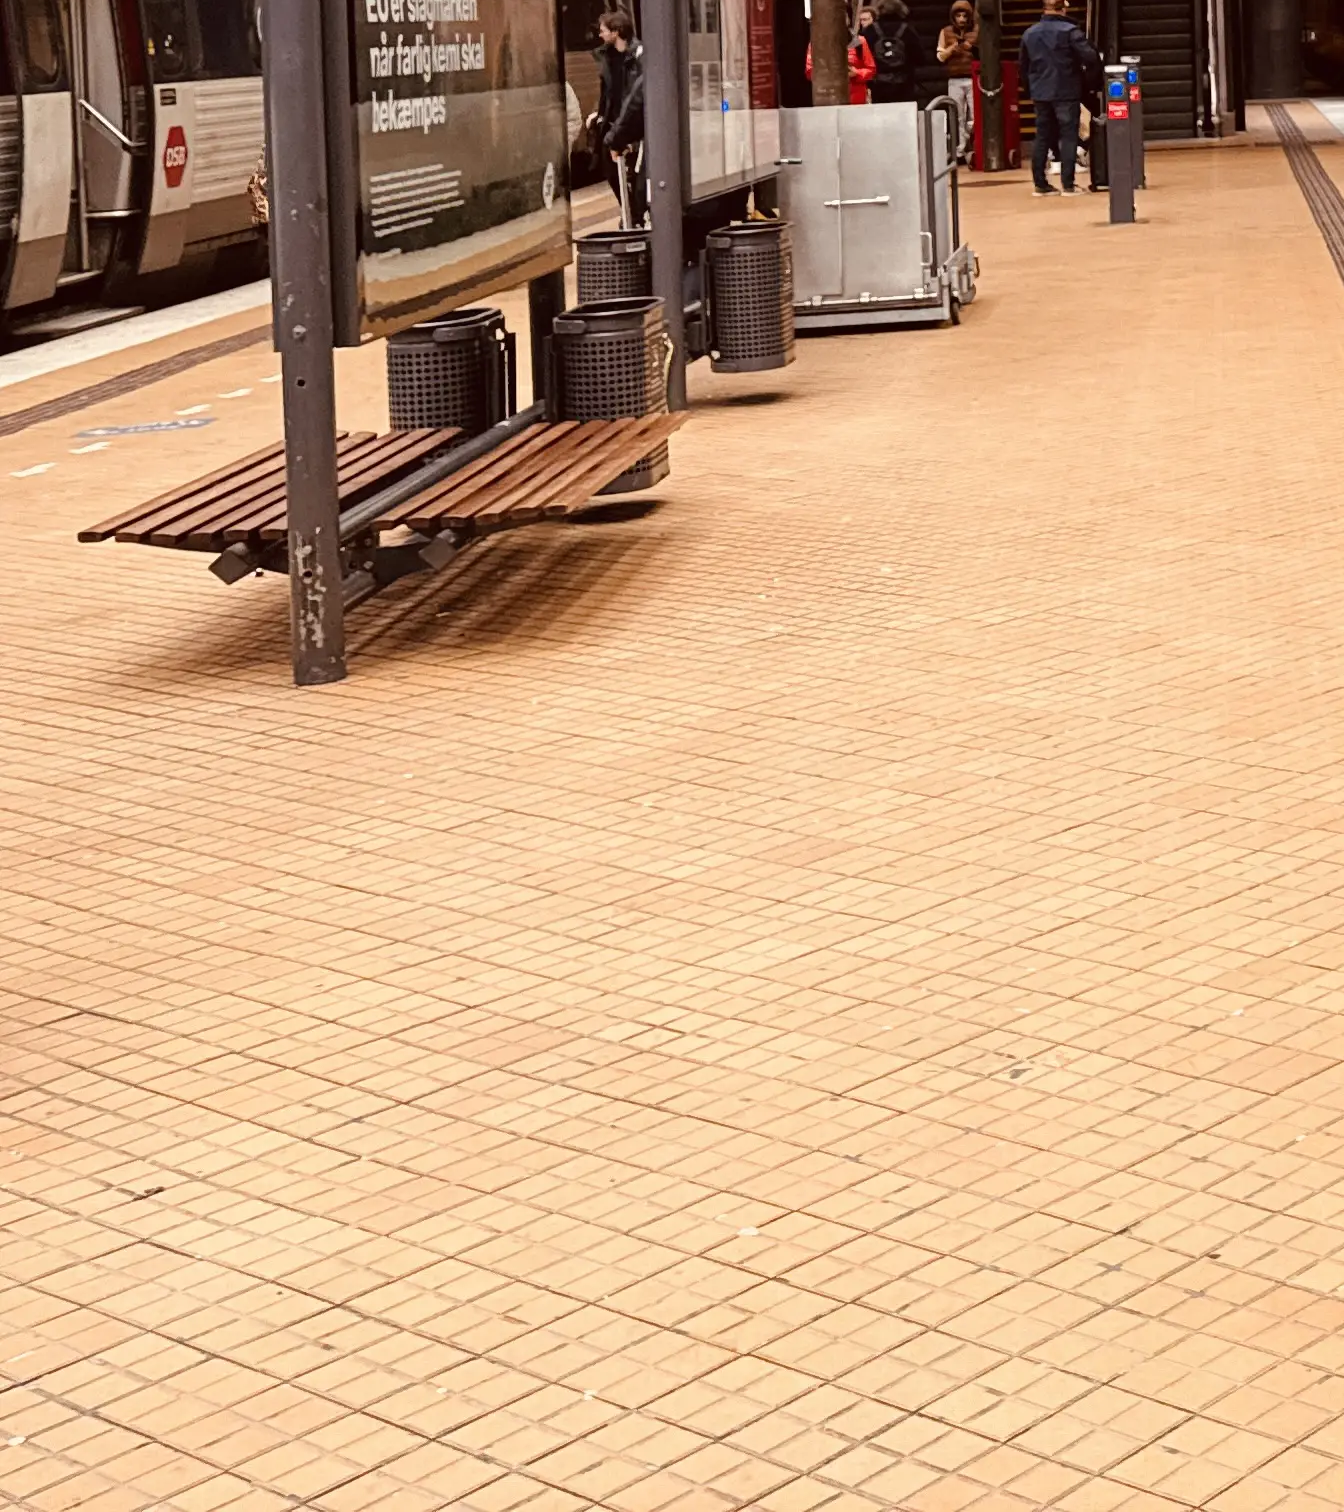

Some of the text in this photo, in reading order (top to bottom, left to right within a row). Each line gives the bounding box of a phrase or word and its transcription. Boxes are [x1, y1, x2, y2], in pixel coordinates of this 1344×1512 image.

[369, 31, 485, 82] når farlig kemi skal
[371, 88, 447, 135] bekæmpes
[166, 145, 186, 168] DSB
